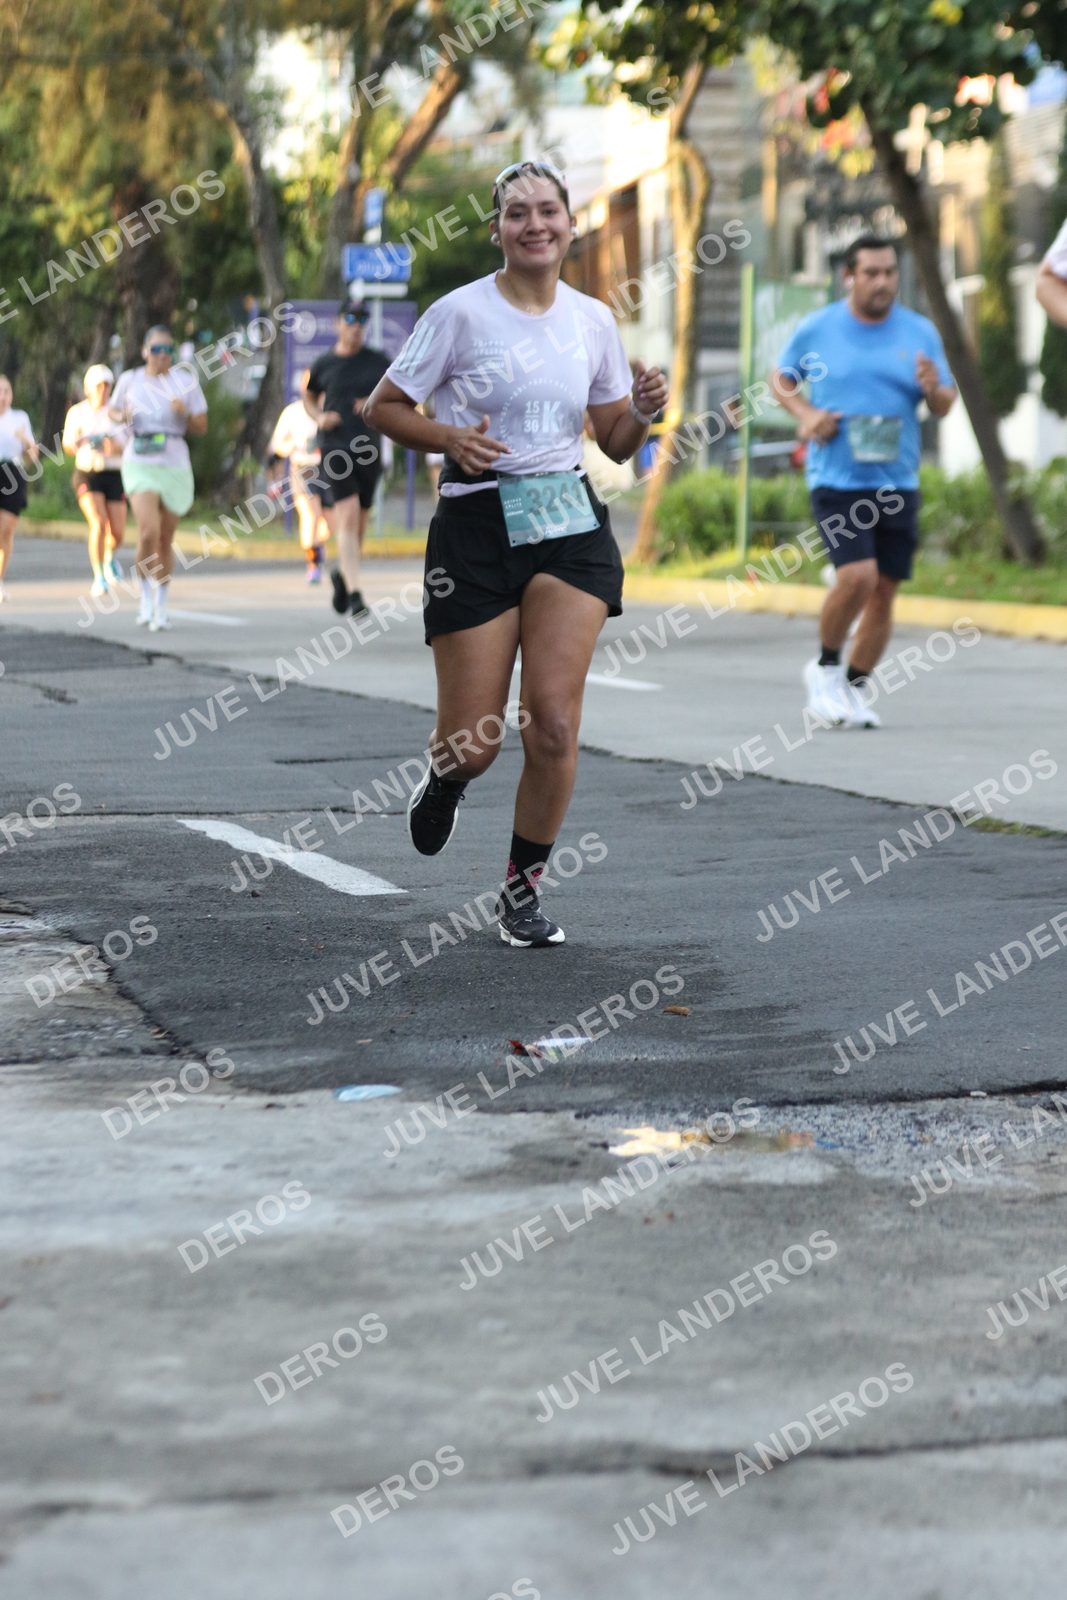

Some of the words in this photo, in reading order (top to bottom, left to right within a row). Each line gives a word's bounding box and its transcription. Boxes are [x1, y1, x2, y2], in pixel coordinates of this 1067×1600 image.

[526, 400, 540, 414] 15
[542, 400, 561, 433] K
[523, 419, 540, 433] 30
[526, 481, 585, 516] 3241
